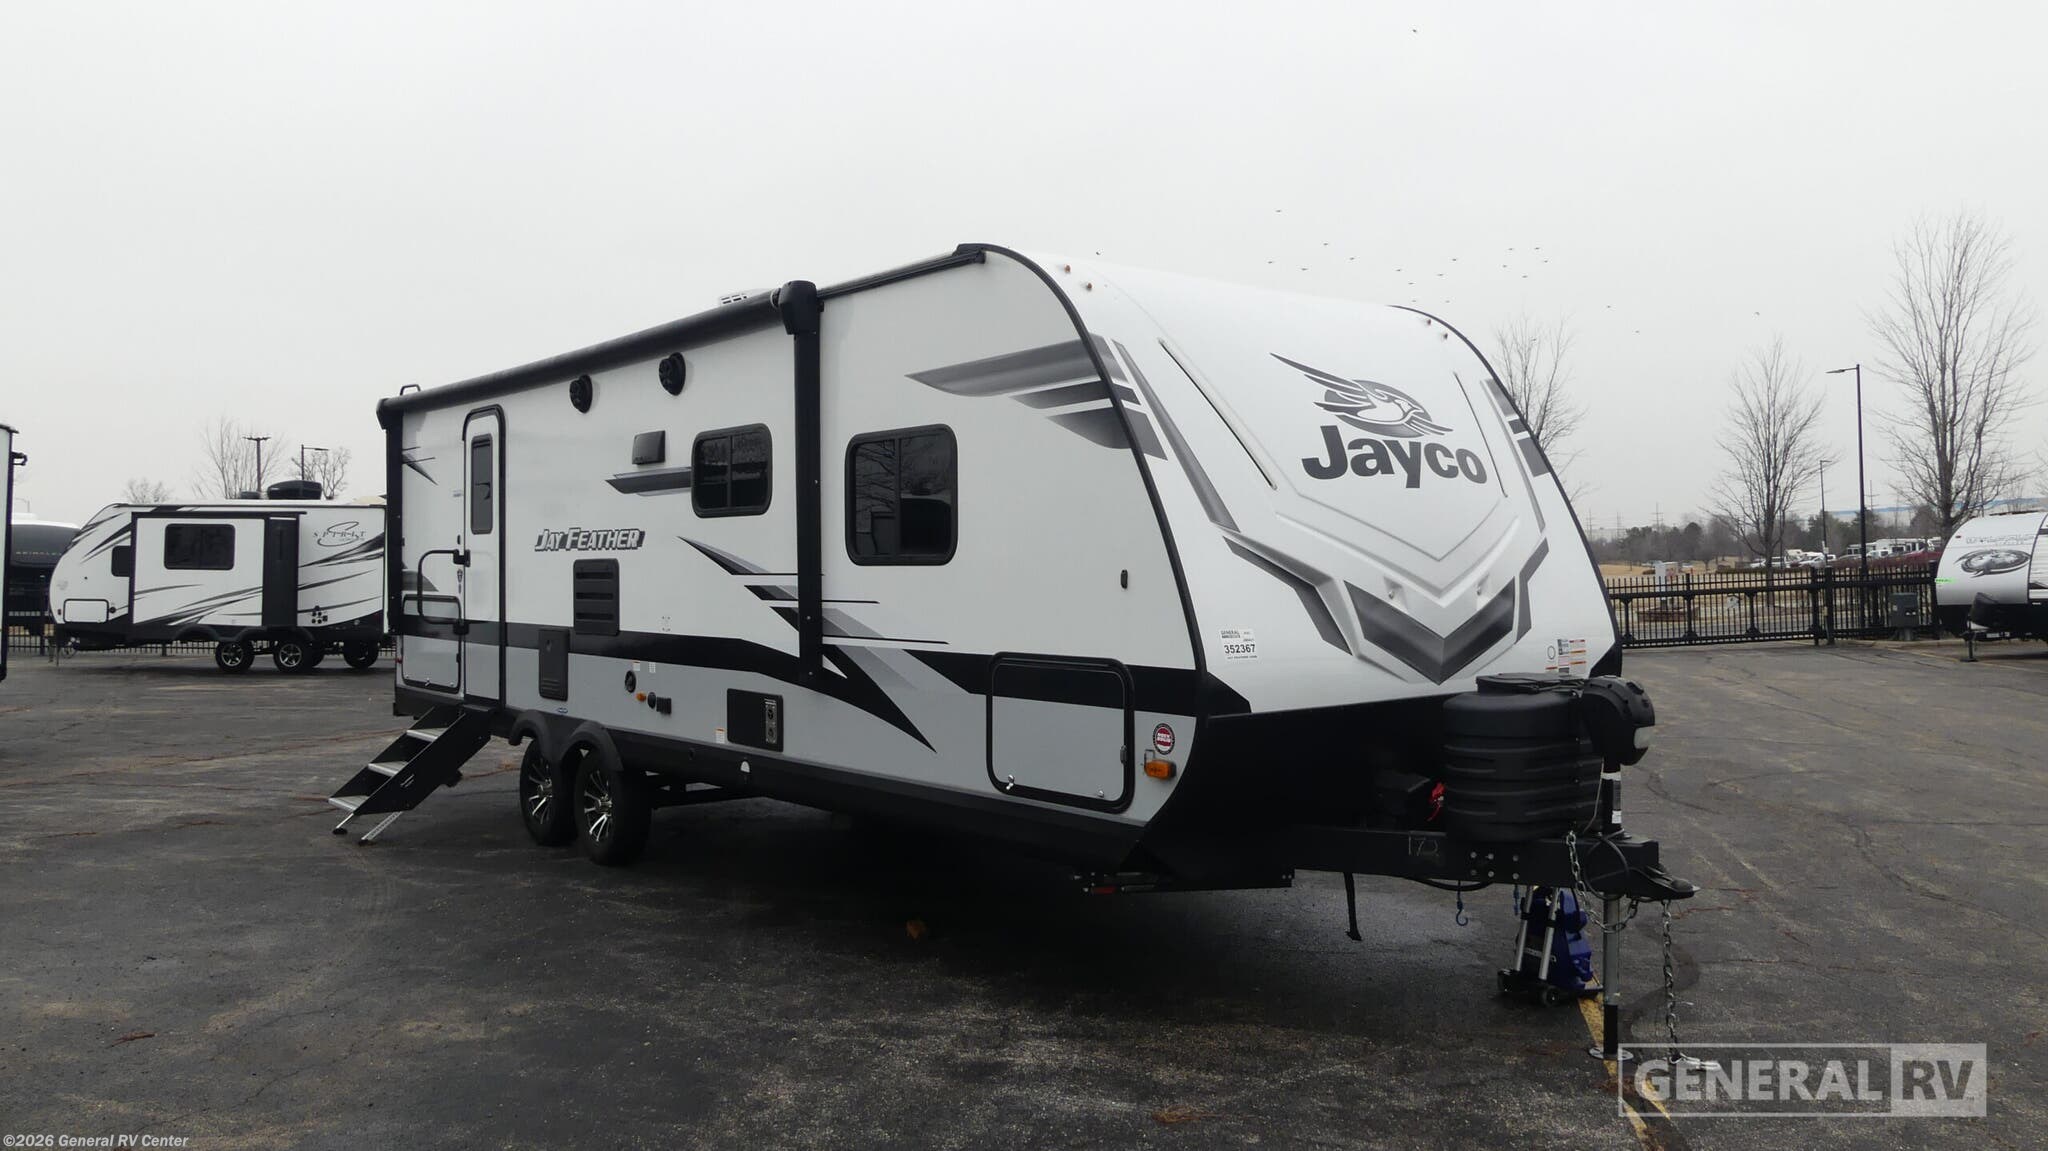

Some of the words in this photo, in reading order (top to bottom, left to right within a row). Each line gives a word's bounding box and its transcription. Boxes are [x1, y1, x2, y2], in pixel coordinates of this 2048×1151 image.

[1301, 425, 1487, 489] Jayco
[566, 527, 641, 550] FEATHER
[1224, 643, 1255, 654] 352367
